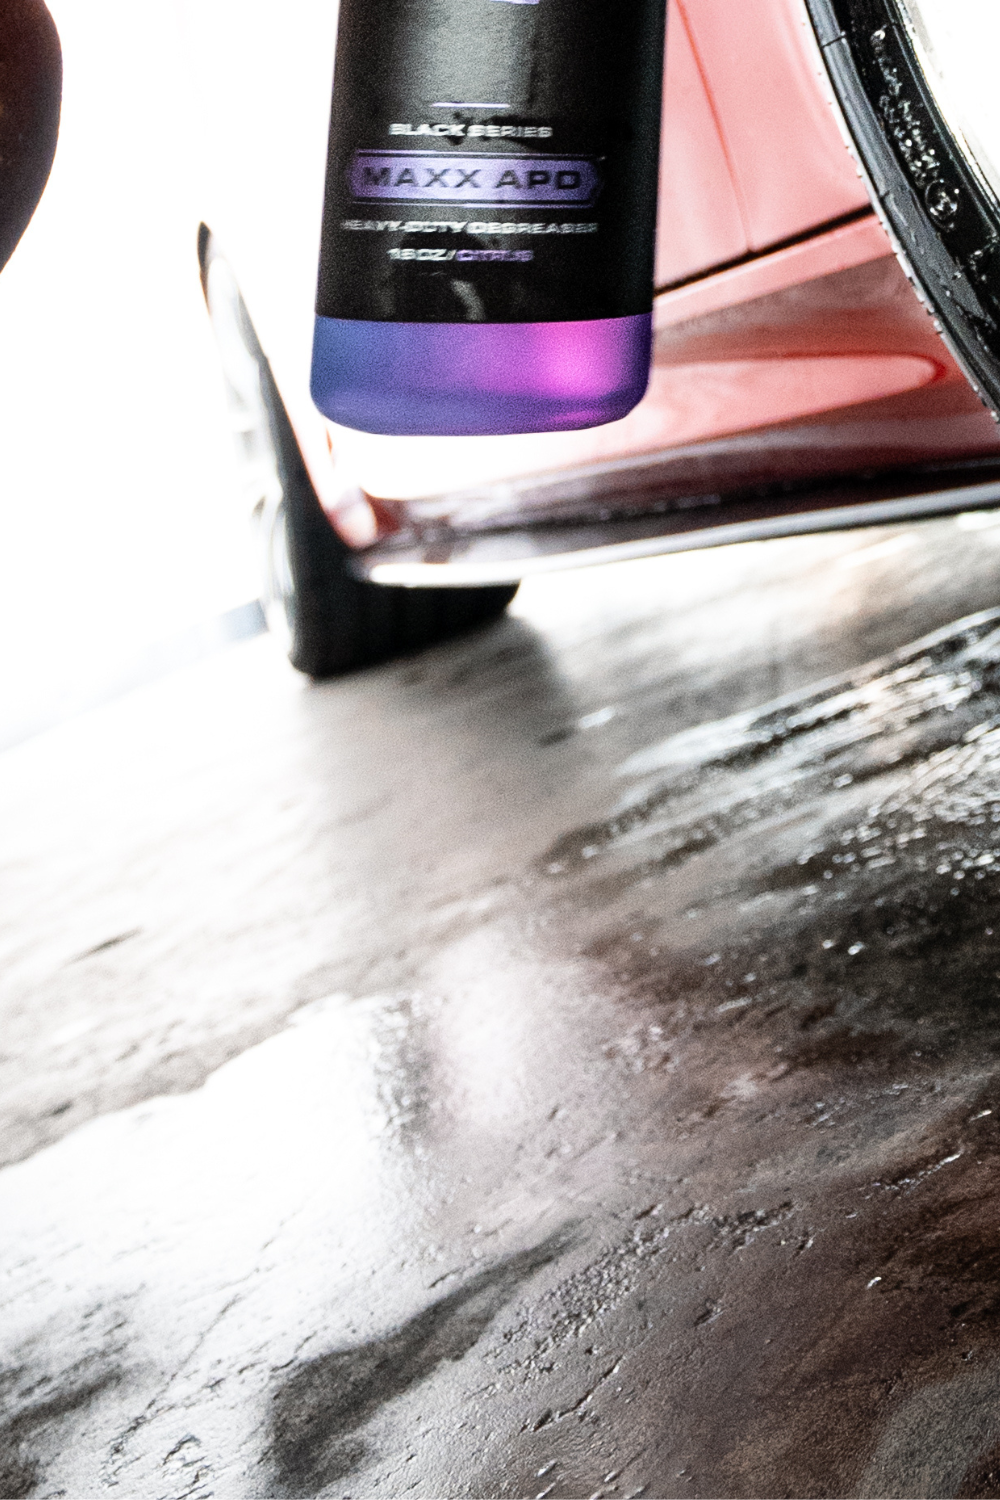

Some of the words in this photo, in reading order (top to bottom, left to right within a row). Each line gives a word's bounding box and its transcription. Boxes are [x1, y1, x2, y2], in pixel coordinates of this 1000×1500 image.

[389, 123, 466, 137] BLACK
[466, 125, 553, 138] SERIES
[362, 167, 482, 188] MAXX
[496, 169, 581, 190] APD
